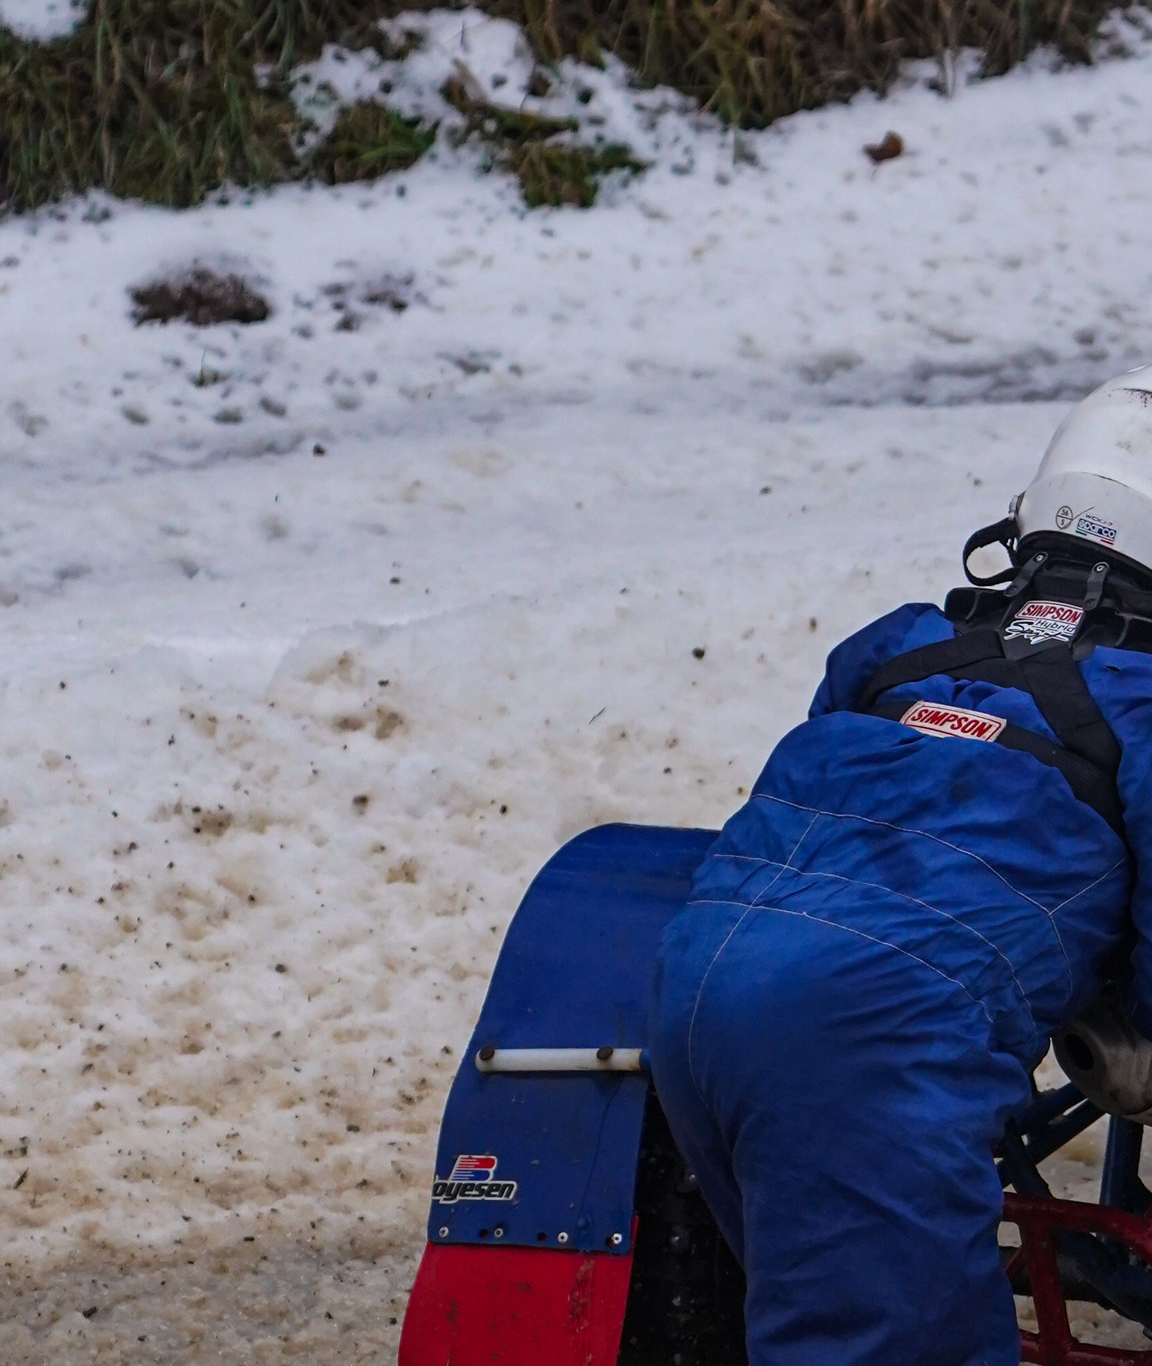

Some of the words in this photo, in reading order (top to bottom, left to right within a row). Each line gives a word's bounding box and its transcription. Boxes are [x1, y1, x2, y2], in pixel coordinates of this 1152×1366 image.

[1022, 604, 1082, 623] SIMPSON
[1034, 618, 1076, 633] Hybrid
[911, 709, 992, 737] SIMPSON
